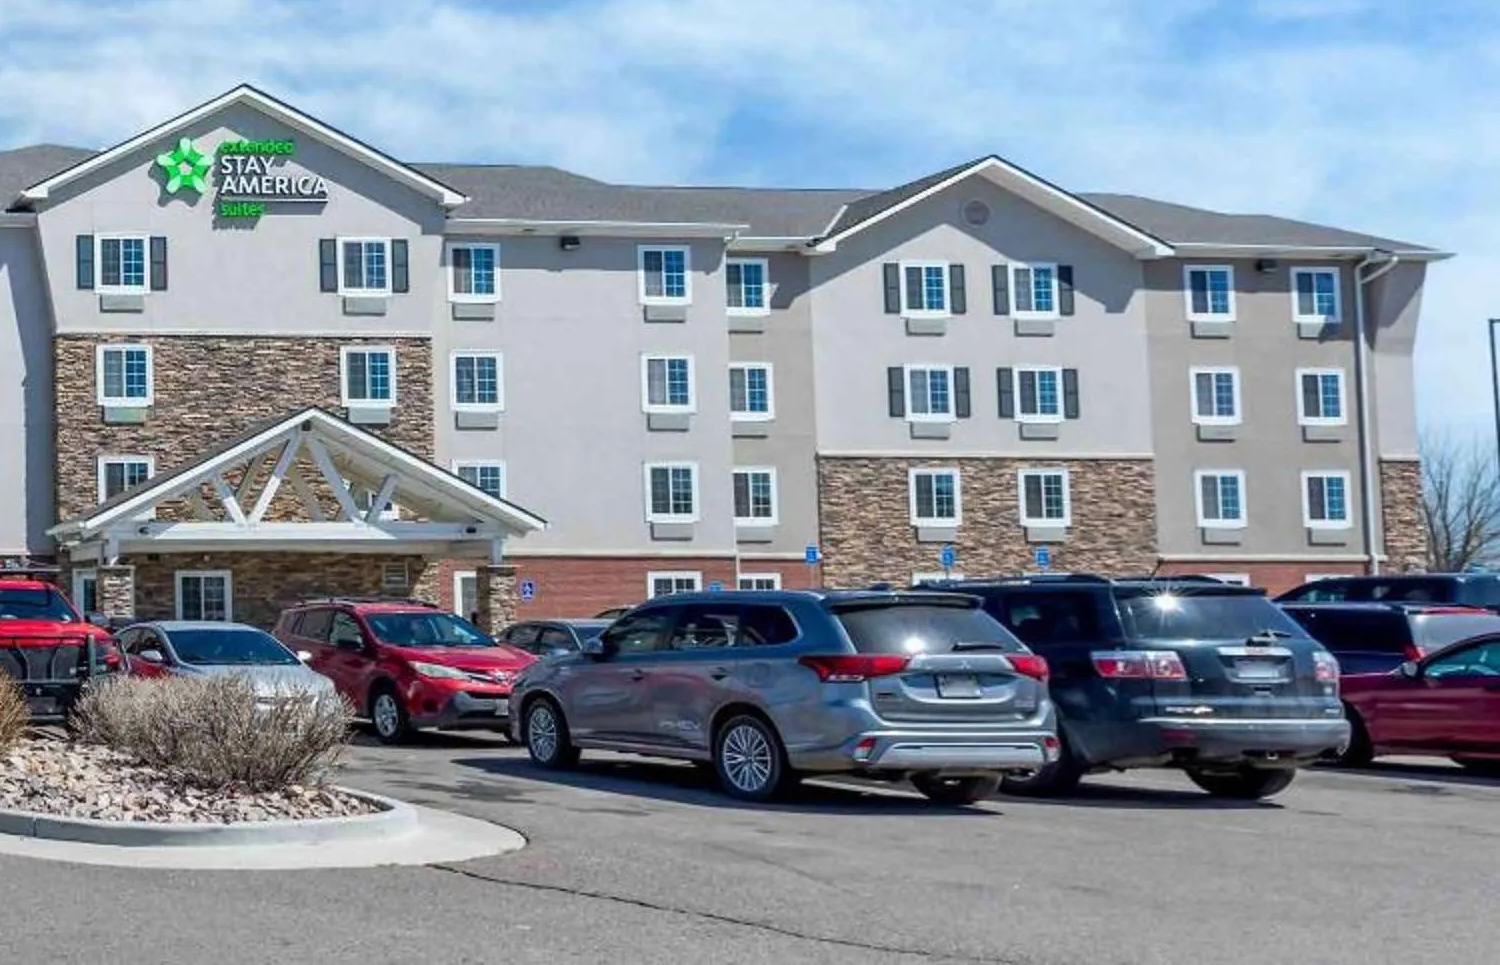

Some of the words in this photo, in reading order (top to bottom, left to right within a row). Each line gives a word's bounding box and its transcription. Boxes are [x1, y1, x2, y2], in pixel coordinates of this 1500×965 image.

[221, 156, 274, 174] STAY
[220, 177, 329, 195] AMERICA
[220, 202, 264, 216] suites
